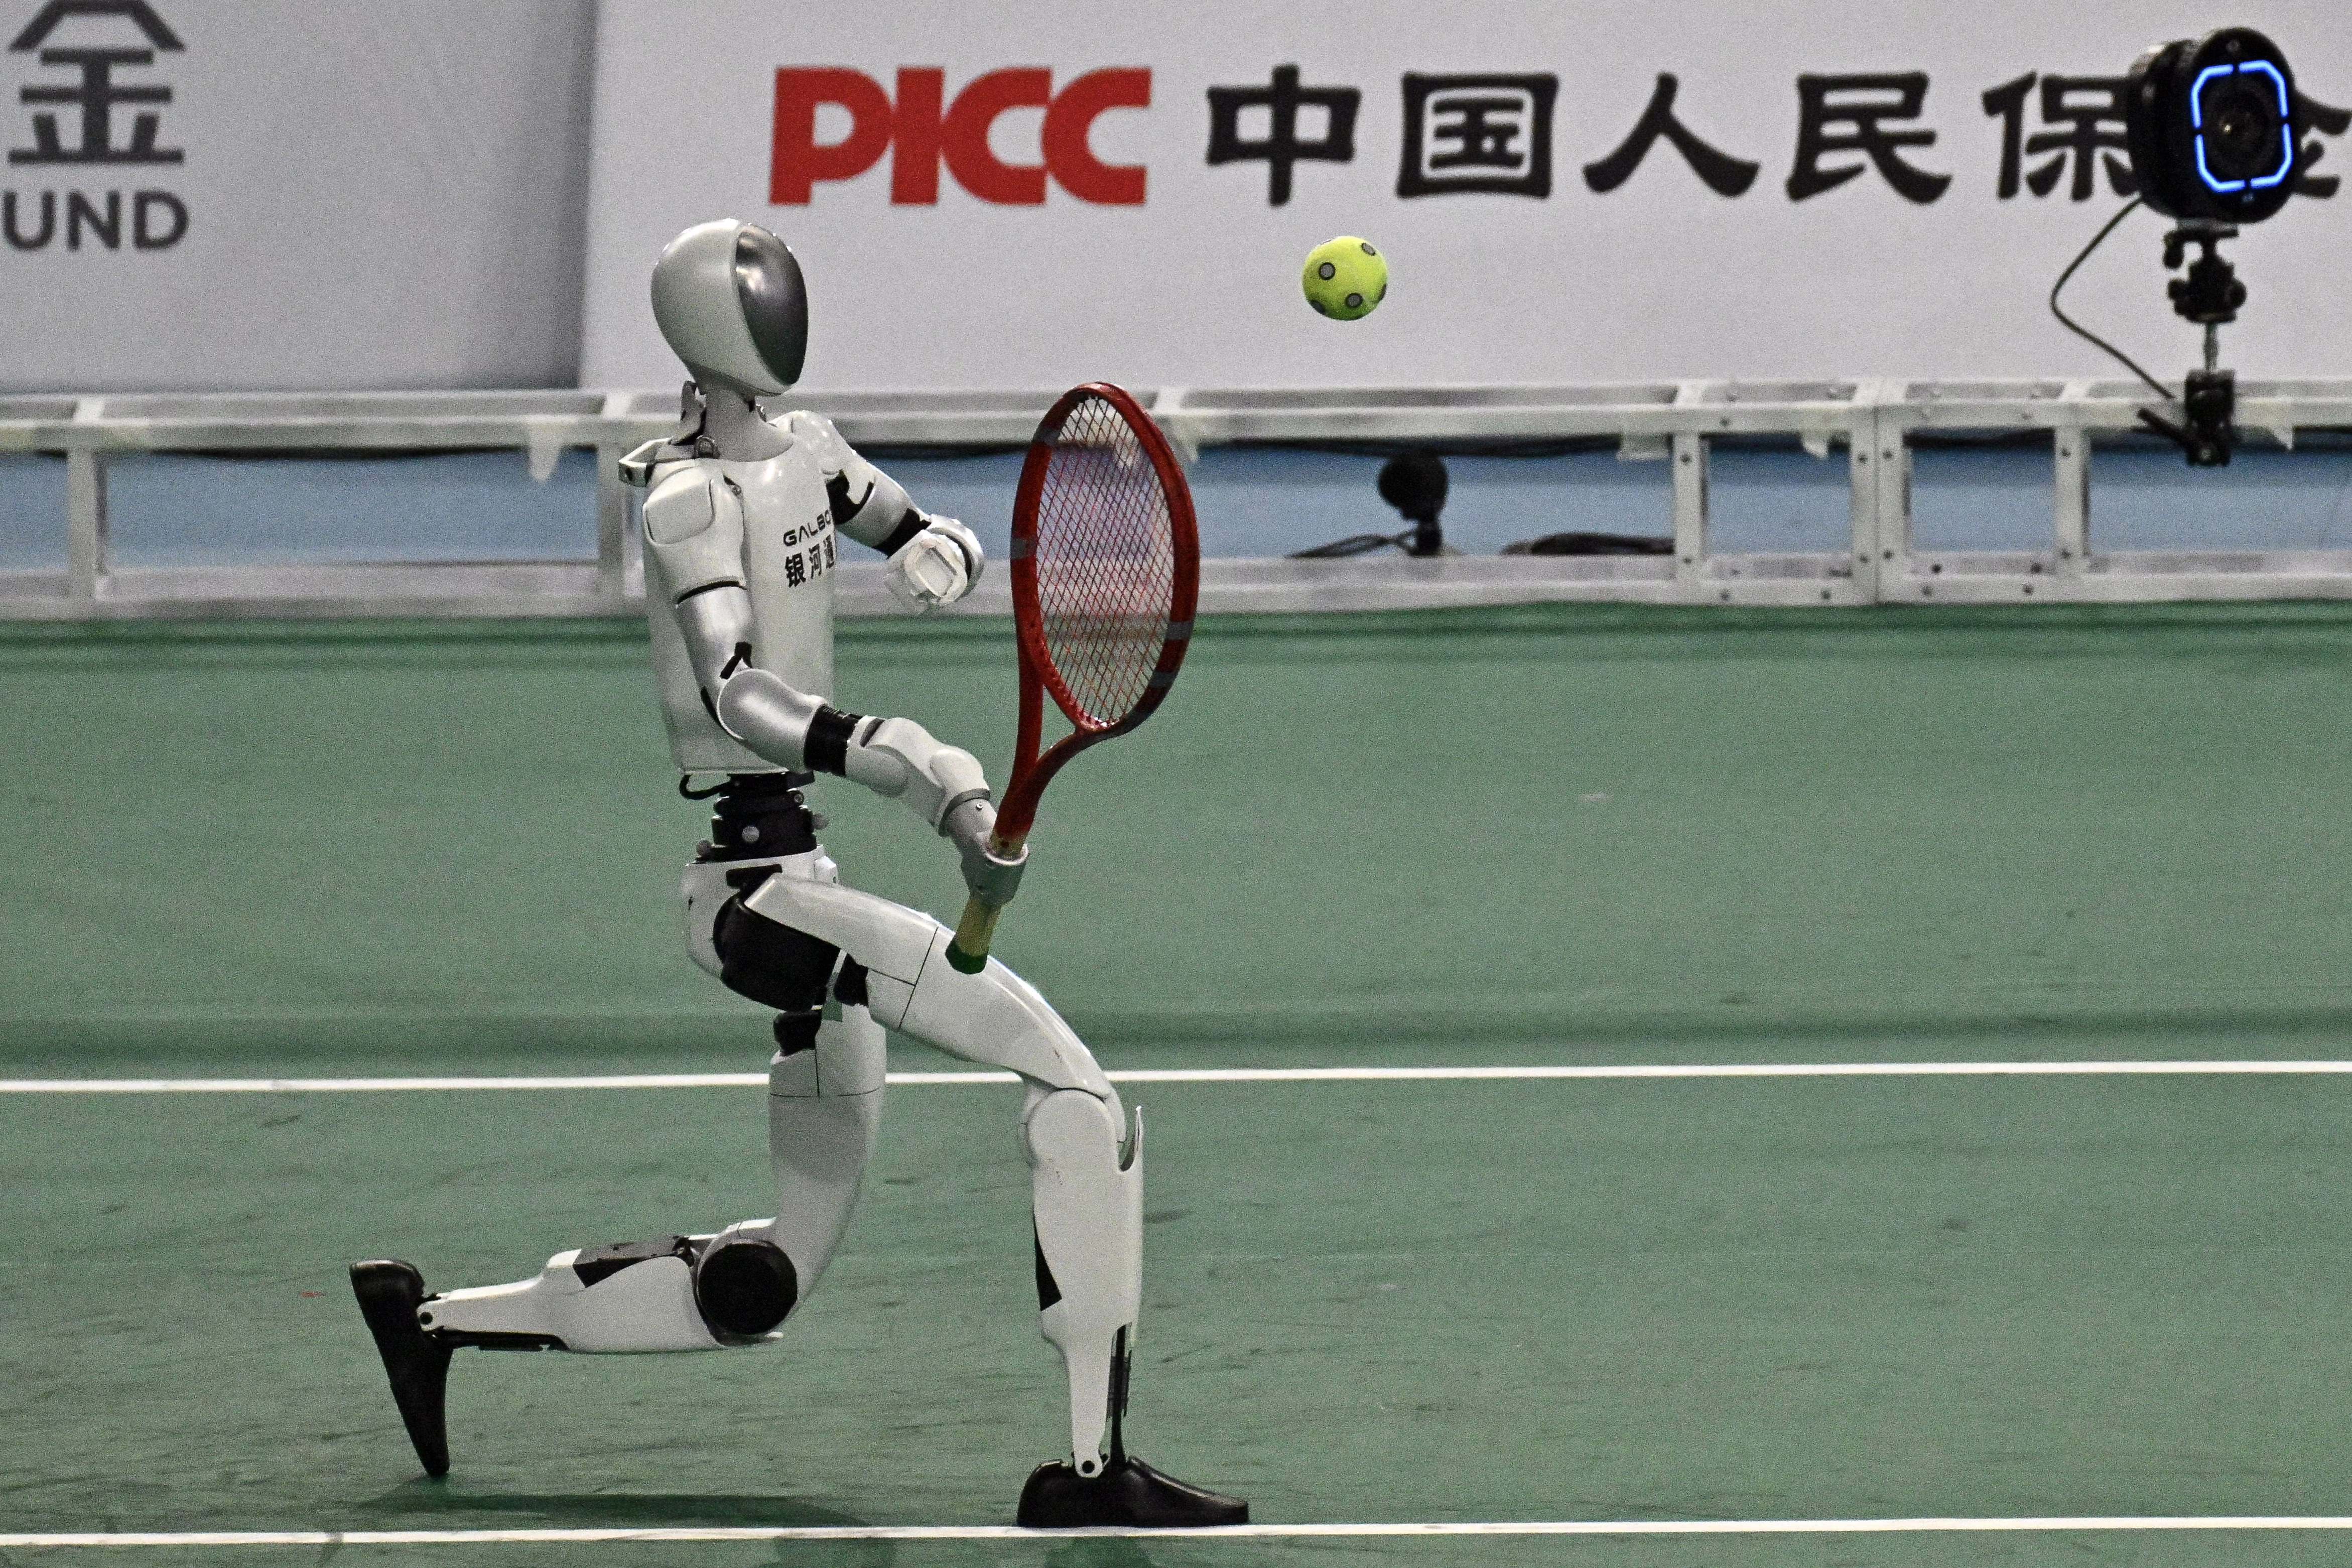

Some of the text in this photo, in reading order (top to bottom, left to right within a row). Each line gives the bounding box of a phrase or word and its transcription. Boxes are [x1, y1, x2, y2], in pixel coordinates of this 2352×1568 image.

[8, 0, 185, 165] 金
[769, 67, 1151, 206] PICC
[785, 534, 835, 588] 银河通
